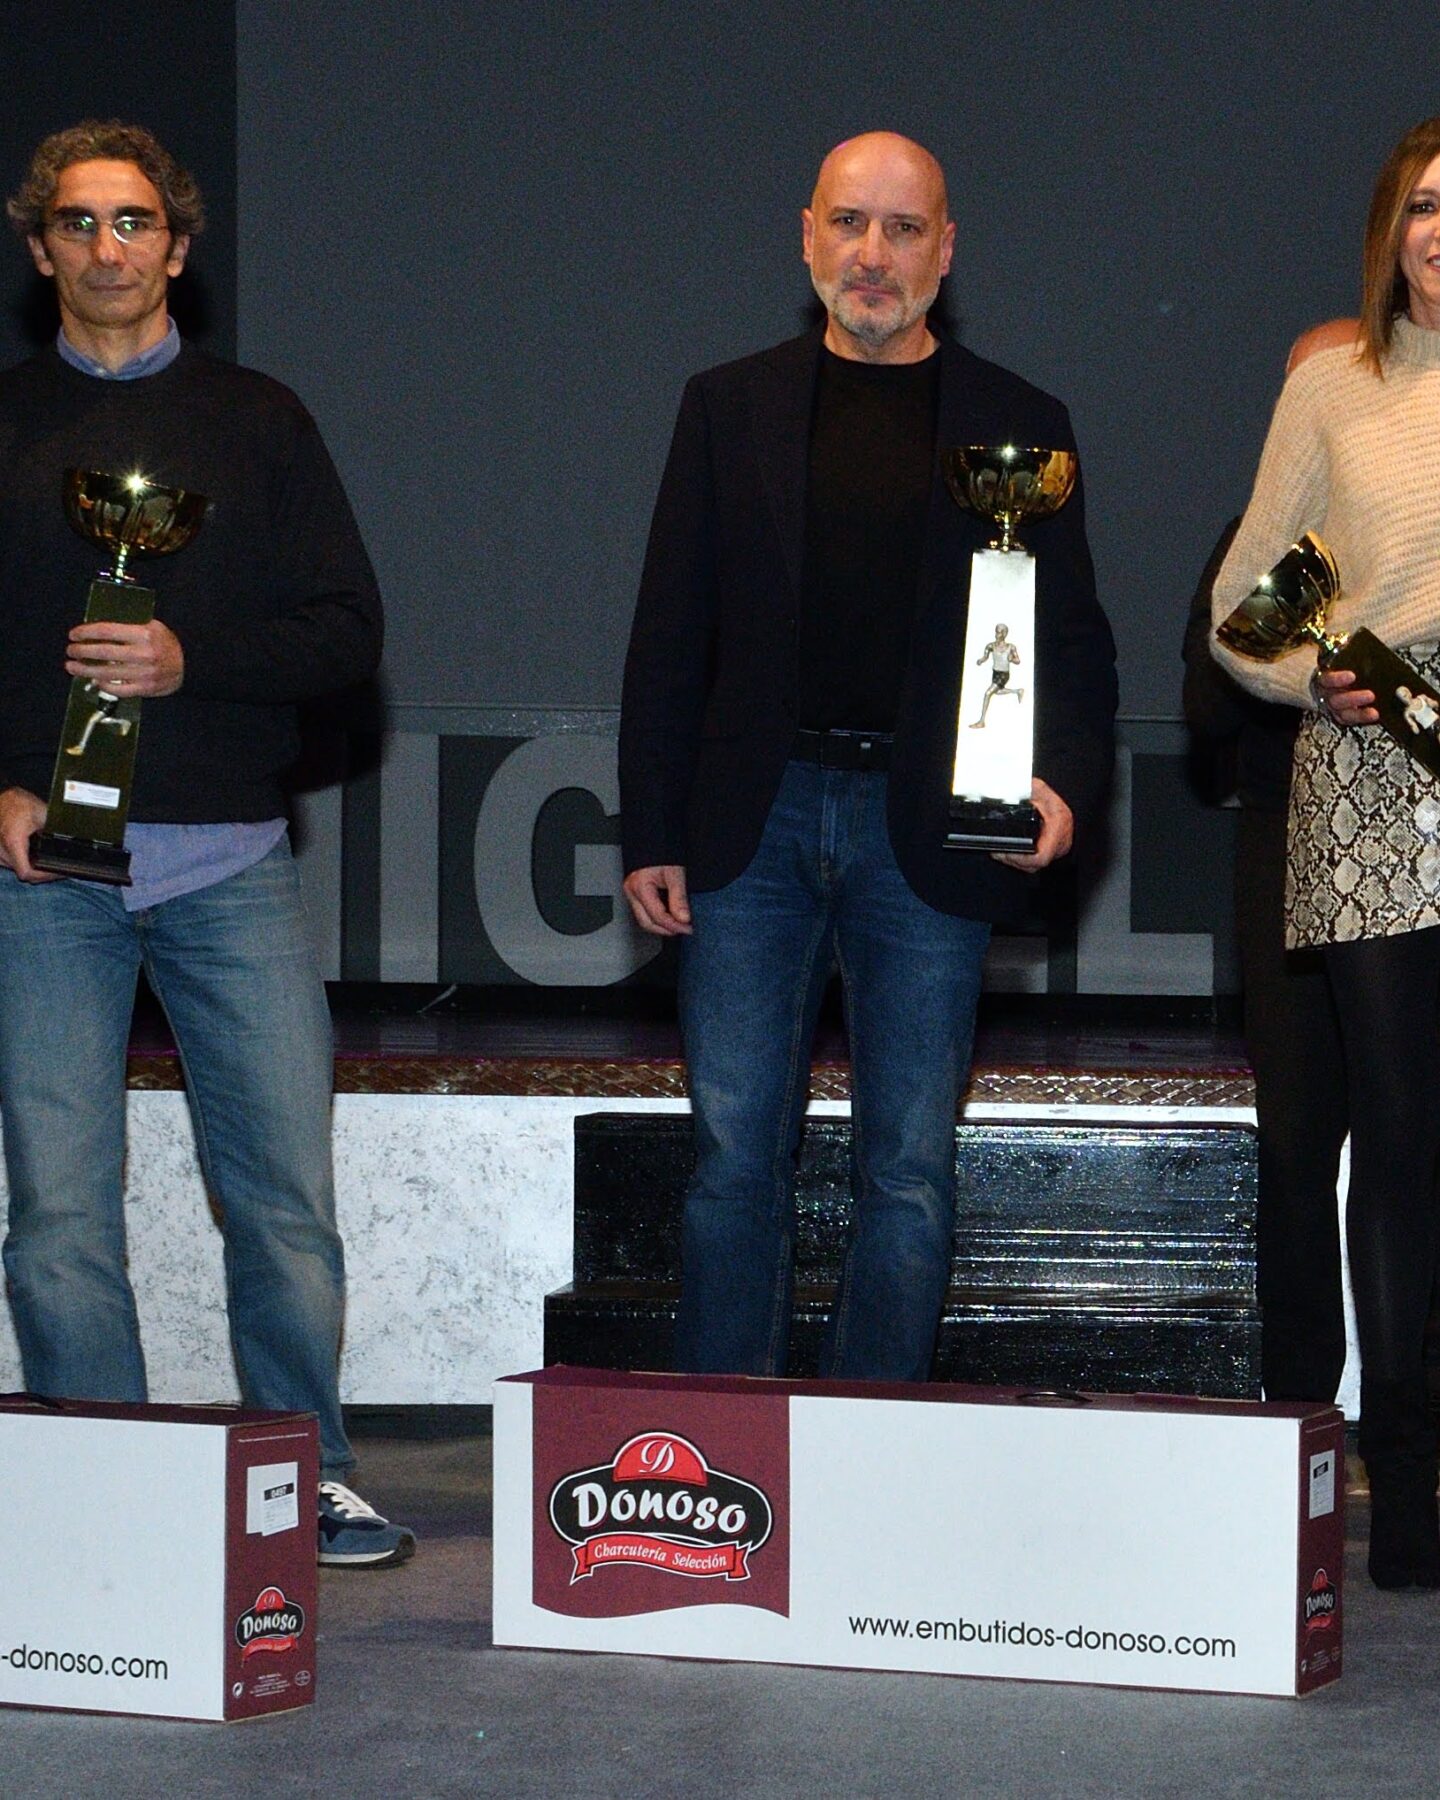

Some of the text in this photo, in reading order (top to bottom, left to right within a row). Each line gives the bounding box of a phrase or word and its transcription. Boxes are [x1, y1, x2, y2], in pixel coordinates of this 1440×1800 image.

[639, 1440, 676, 1474] D
[572, 1483, 747, 1533] Donoso
[594, 1543, 728, 1570] Charcutería Selección
[242, 1613, 297, 1639] Donoso
[849, 1616, 1236, 1658] www.embutidos-donoso.com
